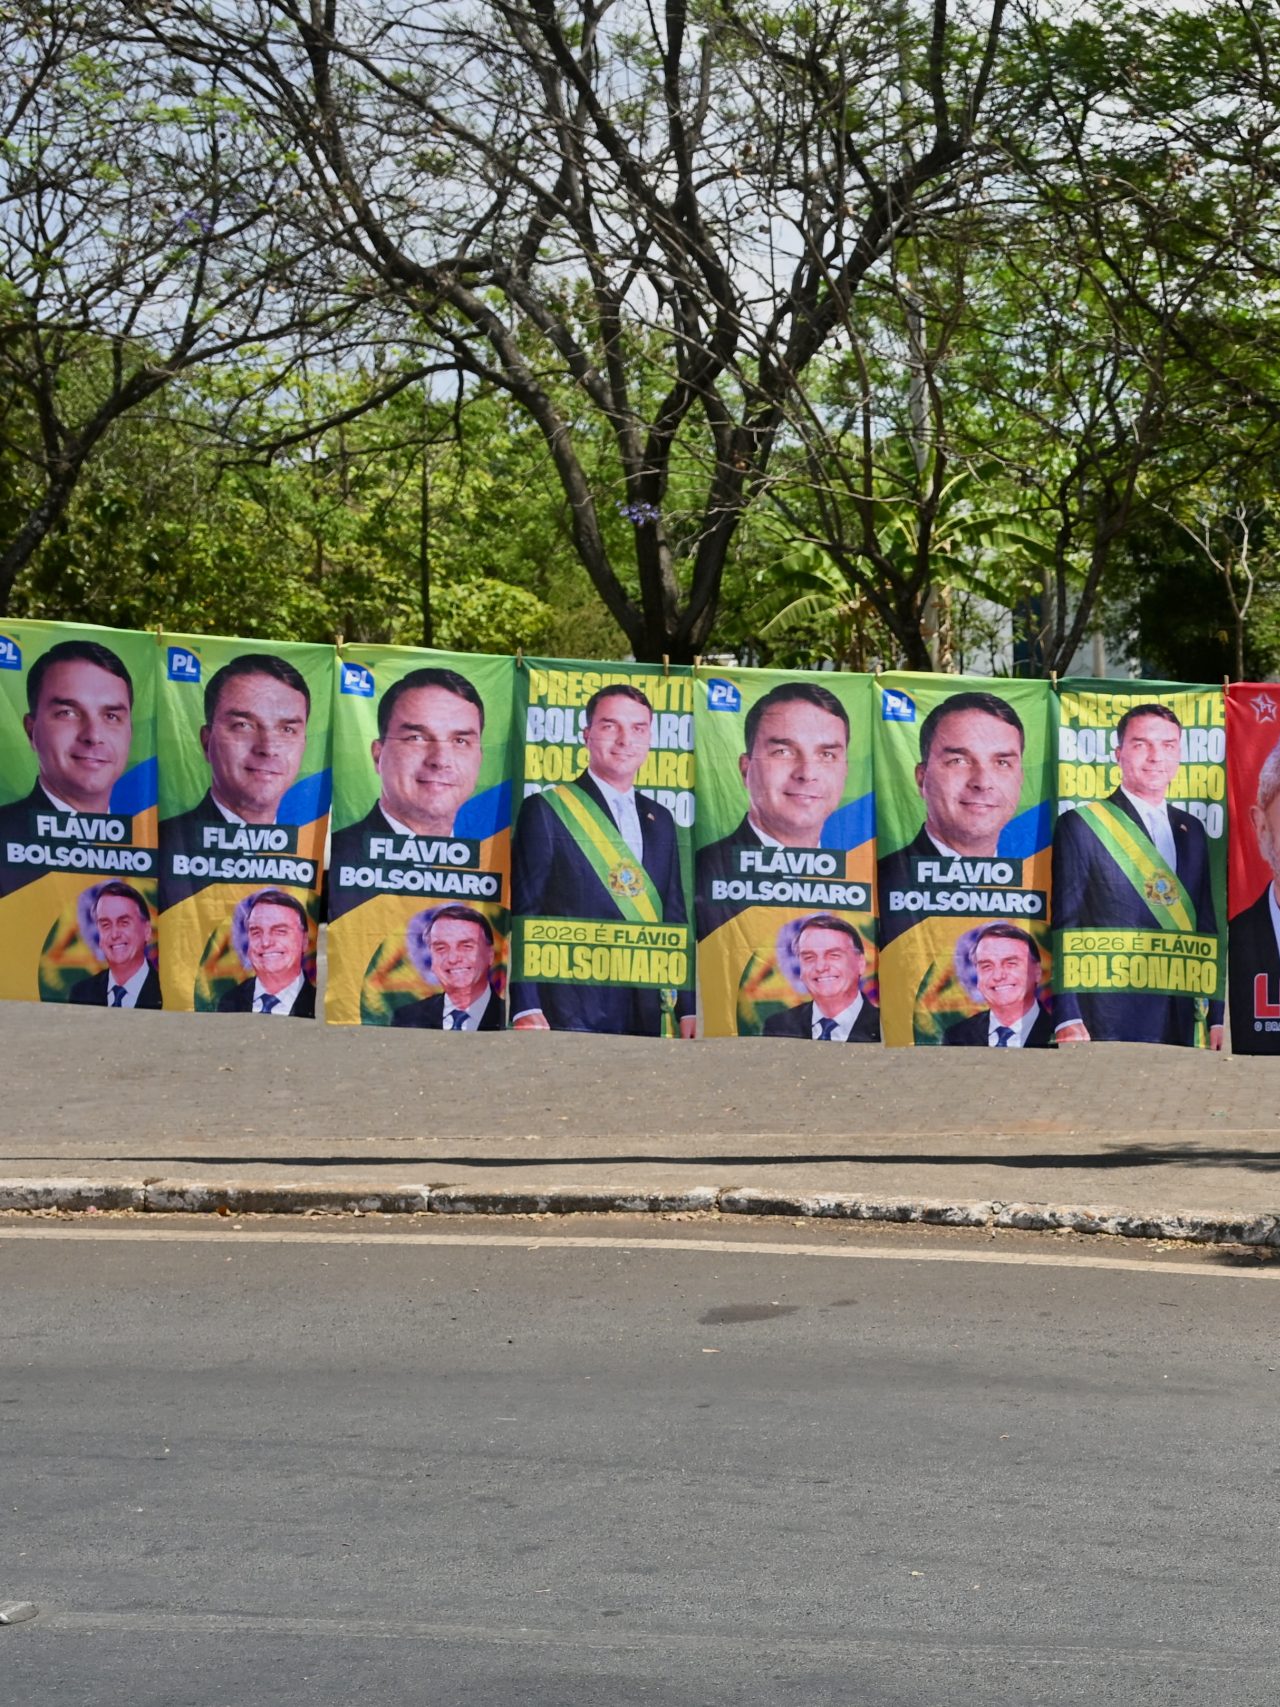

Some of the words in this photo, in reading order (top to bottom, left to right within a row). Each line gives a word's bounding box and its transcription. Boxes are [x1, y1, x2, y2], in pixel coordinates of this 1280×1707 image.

[172, 654, 197, 673] PL
[345, 670, 371, 688] PL
[711, 685, 737, 703] PL
[886, 696, 912, 713] PL
[1260, 703, 1273, 713] PT
[37, 811, 125, 841] FLÁVIO
[203, 821, 288, 851] FLÁVIO
[7, 842, 152, 872] BOLSONARO
[369, 834, 471, 865] FLÁVIO
[740, 847, 837, 876] FLÁVIO
[173, 855, 314, 883] BOLSONARO
[339, 866, 498, 896] BOLSONARO
[918, 855, 1013, 884] FLÁVIO
[712, 880, 866, 906] BOLSONARO
[889, 892, 1043, 914] BOLSONARO
[532, 925, 587, 942] 2026
[595, 924, 607, 943] É
[614, 927, 681, 946] FLÁVIO
[1071, 937, 1125, 951] 2026
[1132, 933, 1144, 951] É
[1151, 935, 1211, 956] FLÁVIO
[524, 943, 687, 985] BOLSONARO
[1063, 954, 1218, 994] BOLSONARO
[1254, 1021, 1263, 1032] O
